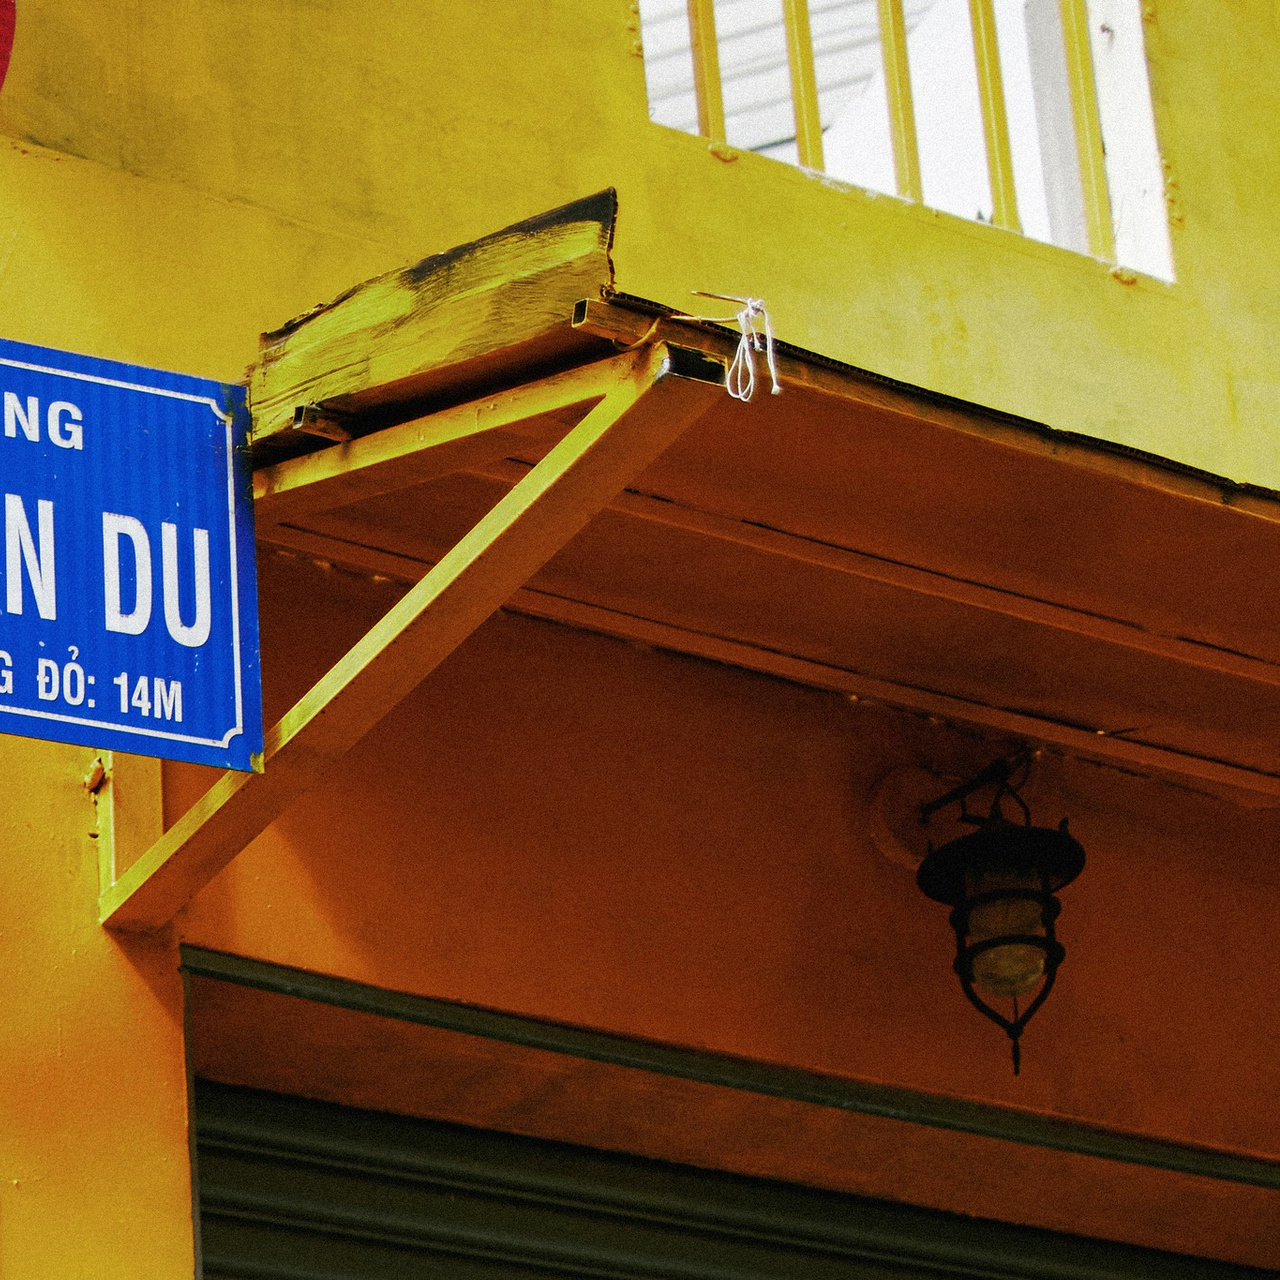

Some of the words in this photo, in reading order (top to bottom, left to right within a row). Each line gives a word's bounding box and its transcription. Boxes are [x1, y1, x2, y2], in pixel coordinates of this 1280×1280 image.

[102, 511, 212, 648] DU
[37, 646, 96, 708] ĐỎ:
[113, 672, 184, 723] 14M
